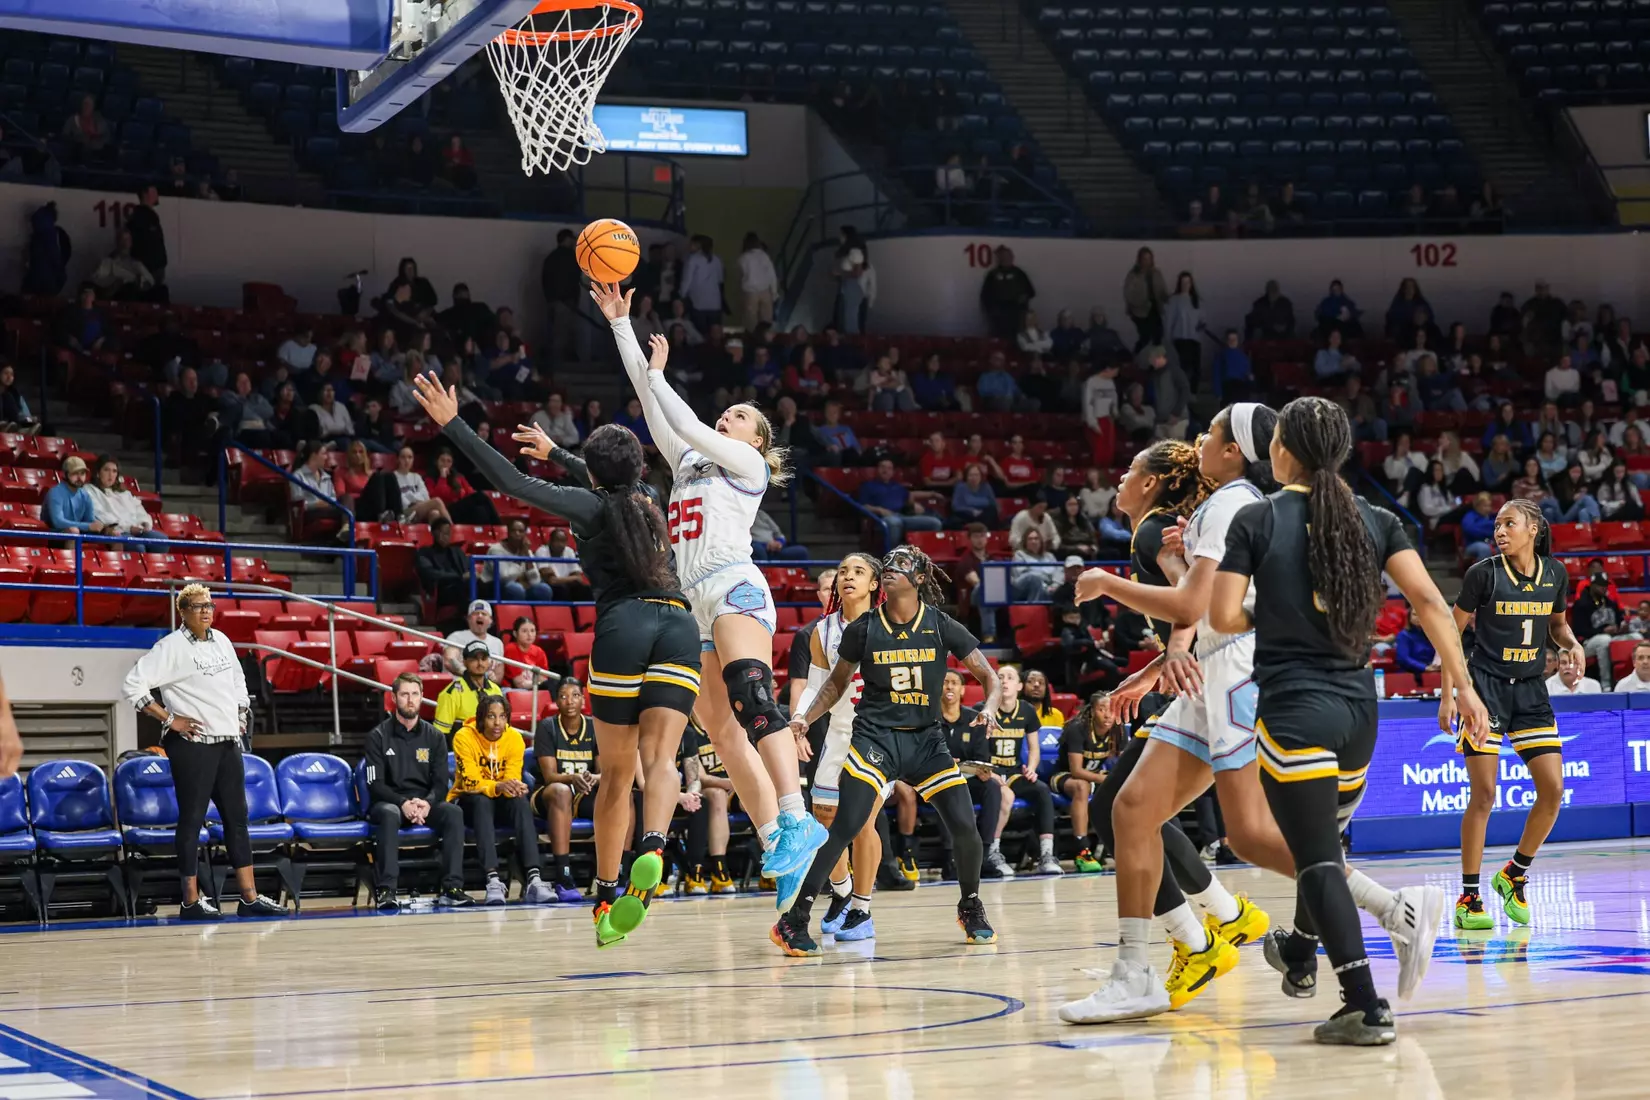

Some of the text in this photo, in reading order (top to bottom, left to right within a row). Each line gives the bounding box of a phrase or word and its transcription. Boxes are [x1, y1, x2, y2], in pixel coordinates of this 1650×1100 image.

[1409, 243, 1458, 268] 102
[668, 497, 704, 545] 25
[1521, 619, 1533, 646] 1
[872, 648, 936, 664] KENNESAW
[890, 666, 923, 691] 21
[890, 691, 930, 706] STATE
[995, 739, 1016, 756] 12
[1421, 785, 1574, 812] Medil Cer
